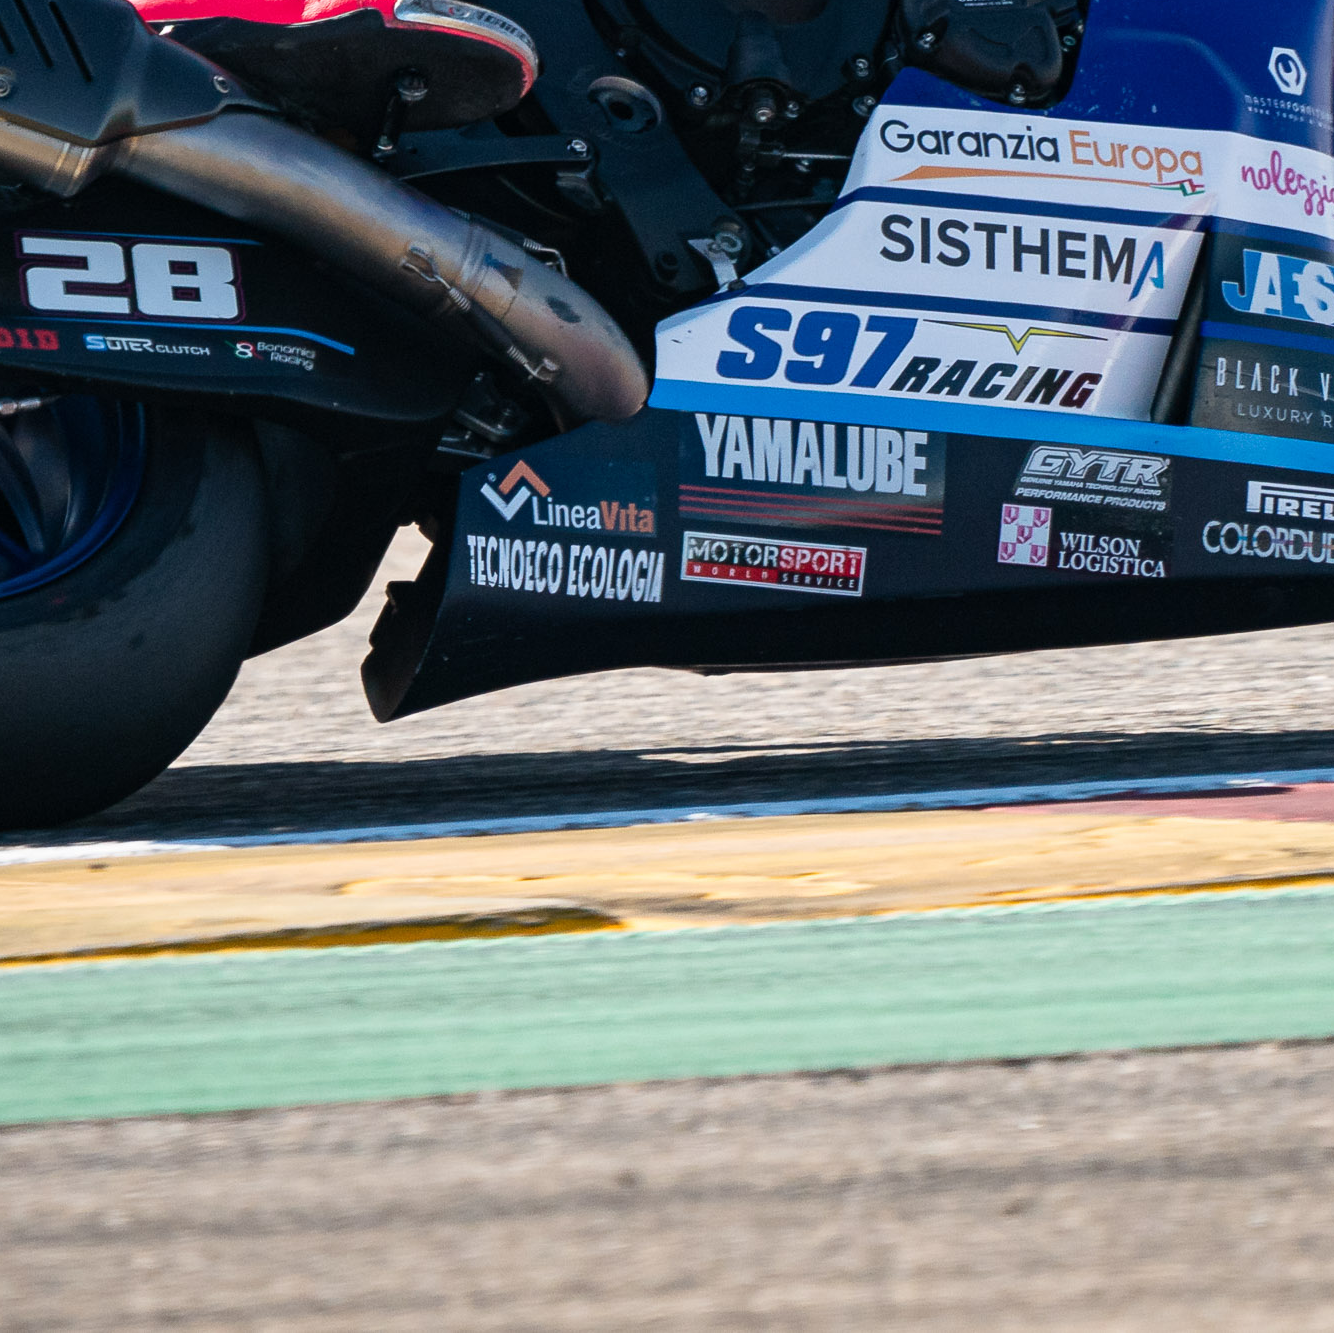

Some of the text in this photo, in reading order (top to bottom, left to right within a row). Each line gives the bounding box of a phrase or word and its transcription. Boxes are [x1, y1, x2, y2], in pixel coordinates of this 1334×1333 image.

[879, 120, 1205, 183] Garanzia Europa
[879, 214, 1165, 302] SISTHEMA
[21, 237, 239, 319] 28
[155, 344, 211, 356] CLUTCH
[716, 305, 1103, 409] S97 RACING
[1216, 356, 1299, 397] BLACK
[1237, 402, 1313, 425] LUXURY
[694, 412, 929, 497] YAMALUBE
[1024, 445, 1167, 487] GYTR
[1015, 487, 1167, 512] PERFORMANCE PRODUCTS
[1054, 479, 1084, 489] YAMAHA
[532, 495, 655, 534] LineaVita
[687, 538, 862, 576] MOTORSPORT
[1058, 531, 1141, 557] WILSON
[467, 534, 665, 603] TECNOECO ECOLOGIA
[781, 572, 855, 588] SERVICE
[1057, 551, 1166, 579] LOGISTICA
